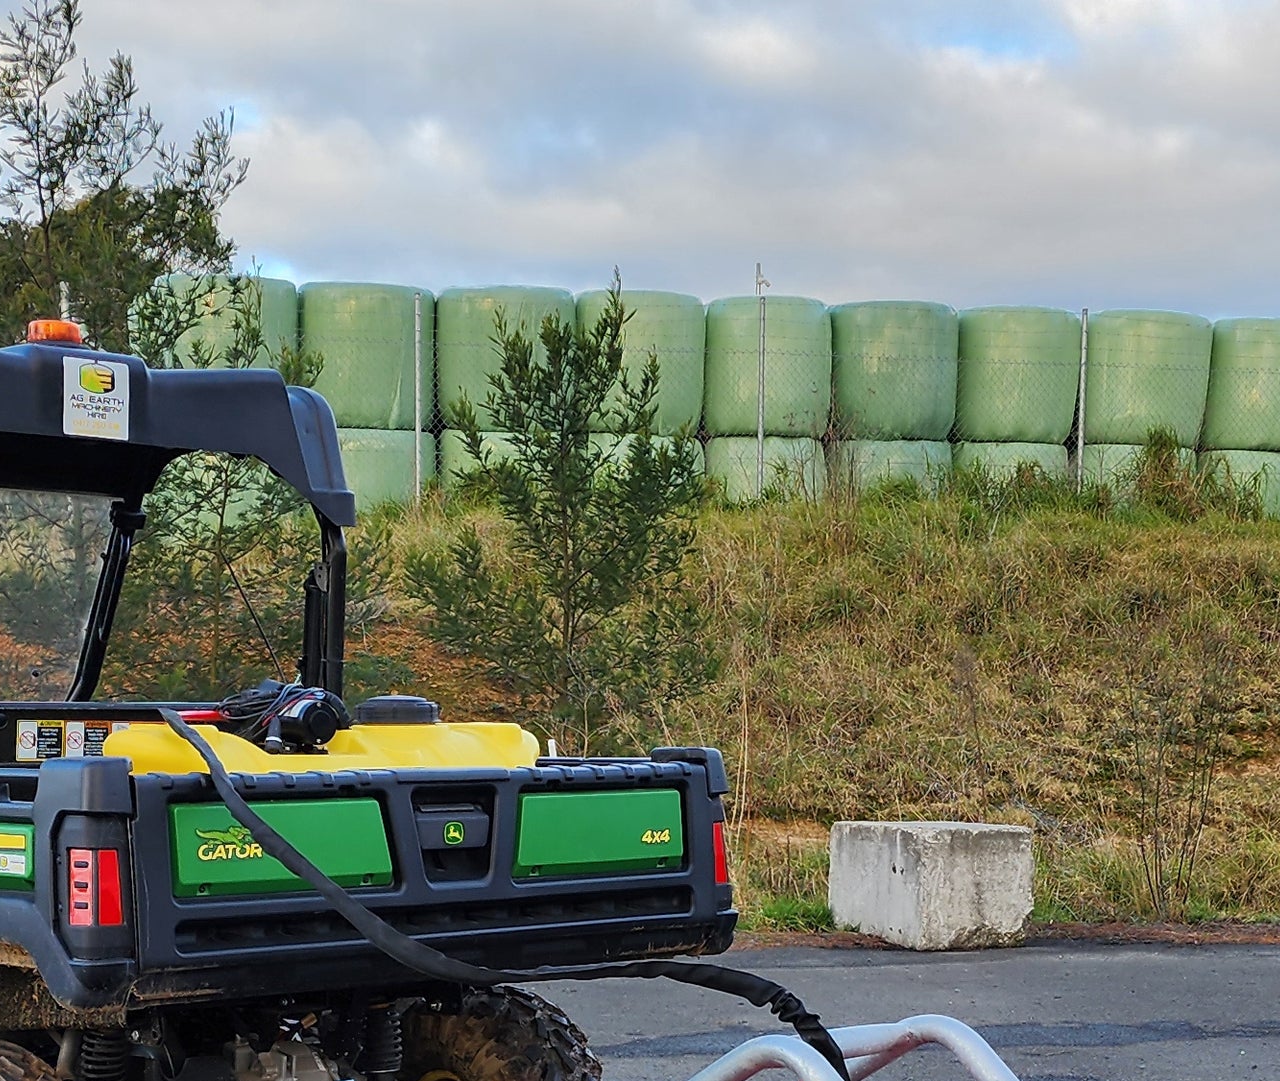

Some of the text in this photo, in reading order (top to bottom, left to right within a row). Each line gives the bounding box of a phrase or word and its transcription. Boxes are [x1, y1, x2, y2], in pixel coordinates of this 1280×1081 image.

[70, 394, 124, 406] AG EARTH
[197, 843, 264, 861] GATOR
